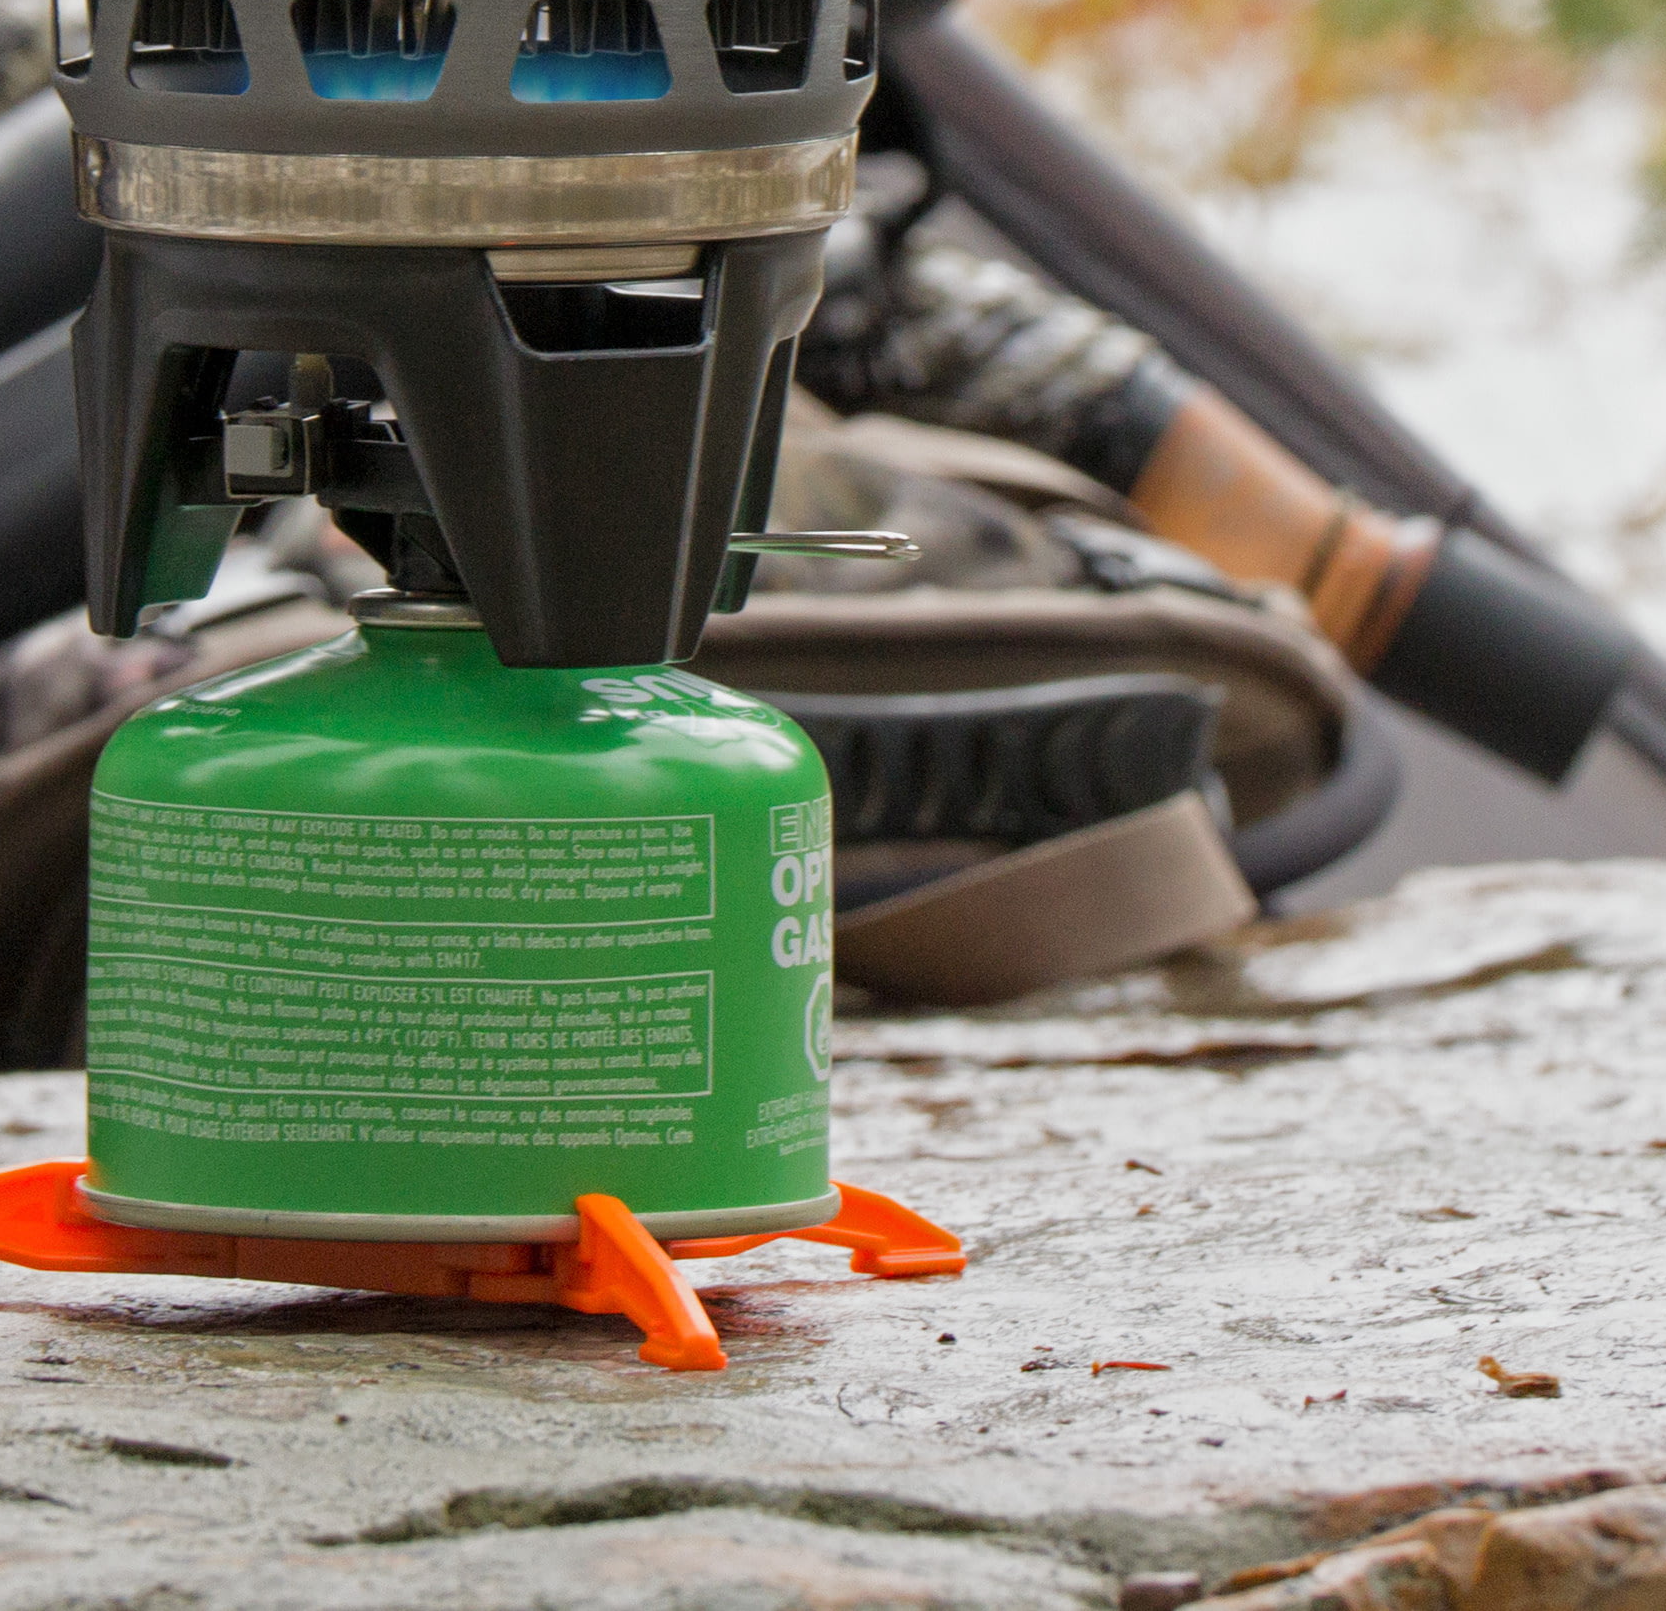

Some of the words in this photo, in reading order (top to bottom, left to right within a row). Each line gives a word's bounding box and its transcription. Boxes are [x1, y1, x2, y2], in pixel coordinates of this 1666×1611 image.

[209, 812, 269, 832] CONTAINER
[271, 817, 297, 833] MAY
[301, 819, 355, 837] EXPLODE
[374, 823, 425, 839] HEATED.
[451, 824, 473, 839] not
[476, 825, 522, 840] smoke.
[547, 825, 569, 840] not
[571, 824, 623, 843] puncture
[639, 822, 669, 839] burn.
[671, 821, 692, 837] Use
[191, 830, 213, 849] pilot
[215, 833, 242, 852] light,
[244, 834, 267, 850] and
[269, 839, 291, 855] any
[293, 837, 331, 858] object
[332, 839, 359, 856] that
[361, 841, 405, 861] sparks,
[408, 843, 438, 858] such
[459, 847, 477, 858] an
[479, 843, 525, 859] electric
[528, 844, 567, 859] motor.
[572, 843, 605, 859] Store
[607, 846, 639, 862] away
[641, 841, 669, 857] from
[671, 839, 697, 856] heat.
[194, 849, 228, 866] REACH
[229, 851, 243, 867] OF
[247, 852, 308, 874] CHILDREN.
[311, 857, 341, 875] Read
[417, 862, 457, 878] before
[459, 867, 487, 878] use.
[491, 863, 525, 878] Avoid
[529, 864, 589, 882] prolonged
[591, 866, 645, 881] exposure
[661, 857, 707, 879] sunlight.
[211, 869, 245, 887] detach
[248, 872, 297, 894] cartridge
[301, 876, 330, 894] from
[333, 879, 391, 901] appliance
[395, 882, 419, 898] and
[422, 883, 454, 898] store
[457, 883, 470, 897] in
[473, 886, 483, 898] a
[485, 883, 516, 902] cool,
[519, 884, 541, 902] dry
[543, 884, 579, 903] place.
[583, 882, 629, 902] Dispose
[647, 879, 682, 899] empty
[203, 914, 237, 932] known
[253, 919, 271, 936] the
[273, 921, 301, 939] state
[303, 925, 317, 941] of
[319, 926, 375, 946] California
[377, 930, 391, 946] to
[393, 934, 429, 947] cause
[431, 935, 474, 950] cancer,
[493, 933, 521, 948] birth
[523, 933, 567, 949] defects
[583, 931, 615, 948] other
[616, 927, 683, 949] reproductive
[683, 923, 713, 941] harm.
[185, 932, 235, 958] appliances
[237, 940, 263, 959] only.
[267, 942, 289, 959] This
[291, 945, 344, 967] cartridge
[347, 950, 401, 971] complies
[405, 952, 433, 967] with
[435, 951, 485, 968] EN417.
[247, 975, 315, 998] CONTENANT
[317, 980, 349, 999] PEUT
[351, 983, 417, 1003] EXPLOSER
[419, 986, 445, 1004] S'IL
[449, 986, 473, 1004] EST
[475, 985, 537, 1005] CHAUFFÉ.
[561, 992, 583, 1009] pas
[585, 987, 623, 1004] fumer.
[645, 987, 665, 1004] pas
[666, 981, 707, 1002] perforer
[251, 1002, 271, 1016] une
[273, 1001, 319, 1019] flamme
[321, 1004, 357, 1024] pilote
[396, 1008, 422, 1024] tout
[425, 1010, 459, 1029] objet
[461, 1011, 527, 1030] produisant
[529, 1012, 553, 1027] des
[555, 1010, 615, 1029] étincelles,
[653, 1004, 691, 1022] moteur
[282, 1024, 349, 1045] supérieures
[364, 1027, 401, 1044] 49°C
[405, 1029, 467, 1048] (120°F).
[469, 1031, 507, 1048] TENIR
[511, 1032, 547, 1049] HORS
[551, 1031, 567, 1049] DE
[571, 1026, 617, 1048] PORTÉE
[619, 1027, 643, 1046] DES
[645, 1025, 693, 1044] ENFANTS.
[297, 1047, 325, 1067] peut
[327, 1051, 389, 1069] provoquer
[391, 1051, 415, 1067] des
[418, 1053, 455, 1069] effets
[458, 1057, 478, 1070] sur
[496, 1055, 549, 1074] système
[552, 1056, 601, 1070] nerveux
[603, 1051, 645, 1069] central.
[255, 1070, 302, 1089] Disposer
[323, 1071, 385, 1088] contenant
[389, 1073, 415, 1089] vide
[418, 1075, 454, 1091] selon
[479, 1077, 549, 1095] règlements
[237, 1101, 266, 1117] selon
[334, 1103, 396, 1123] Californie,
[399, 1105, 451, 1121] causent
[469, 1109, 515, 1126] cancer,
[539, 1108, 561, 1123] des
[563, 1107, 625, 1122] anomalies
[627, 1106, 693, 1125] congénitales
[189, 1117, 221, 1139] USAGE
[281, 1122, 355, 1142] SEULEMENT.
[417, 1128, 495, 1147] uniquement
[497, 1132, 529, 1145] avec
[531, 1130, 555, 1145] des
[557, 1130, 611, 1148] appareils
[613, 1129, 662, 1148] Optimus.
[665, 1128, 693, 1144] Cette
